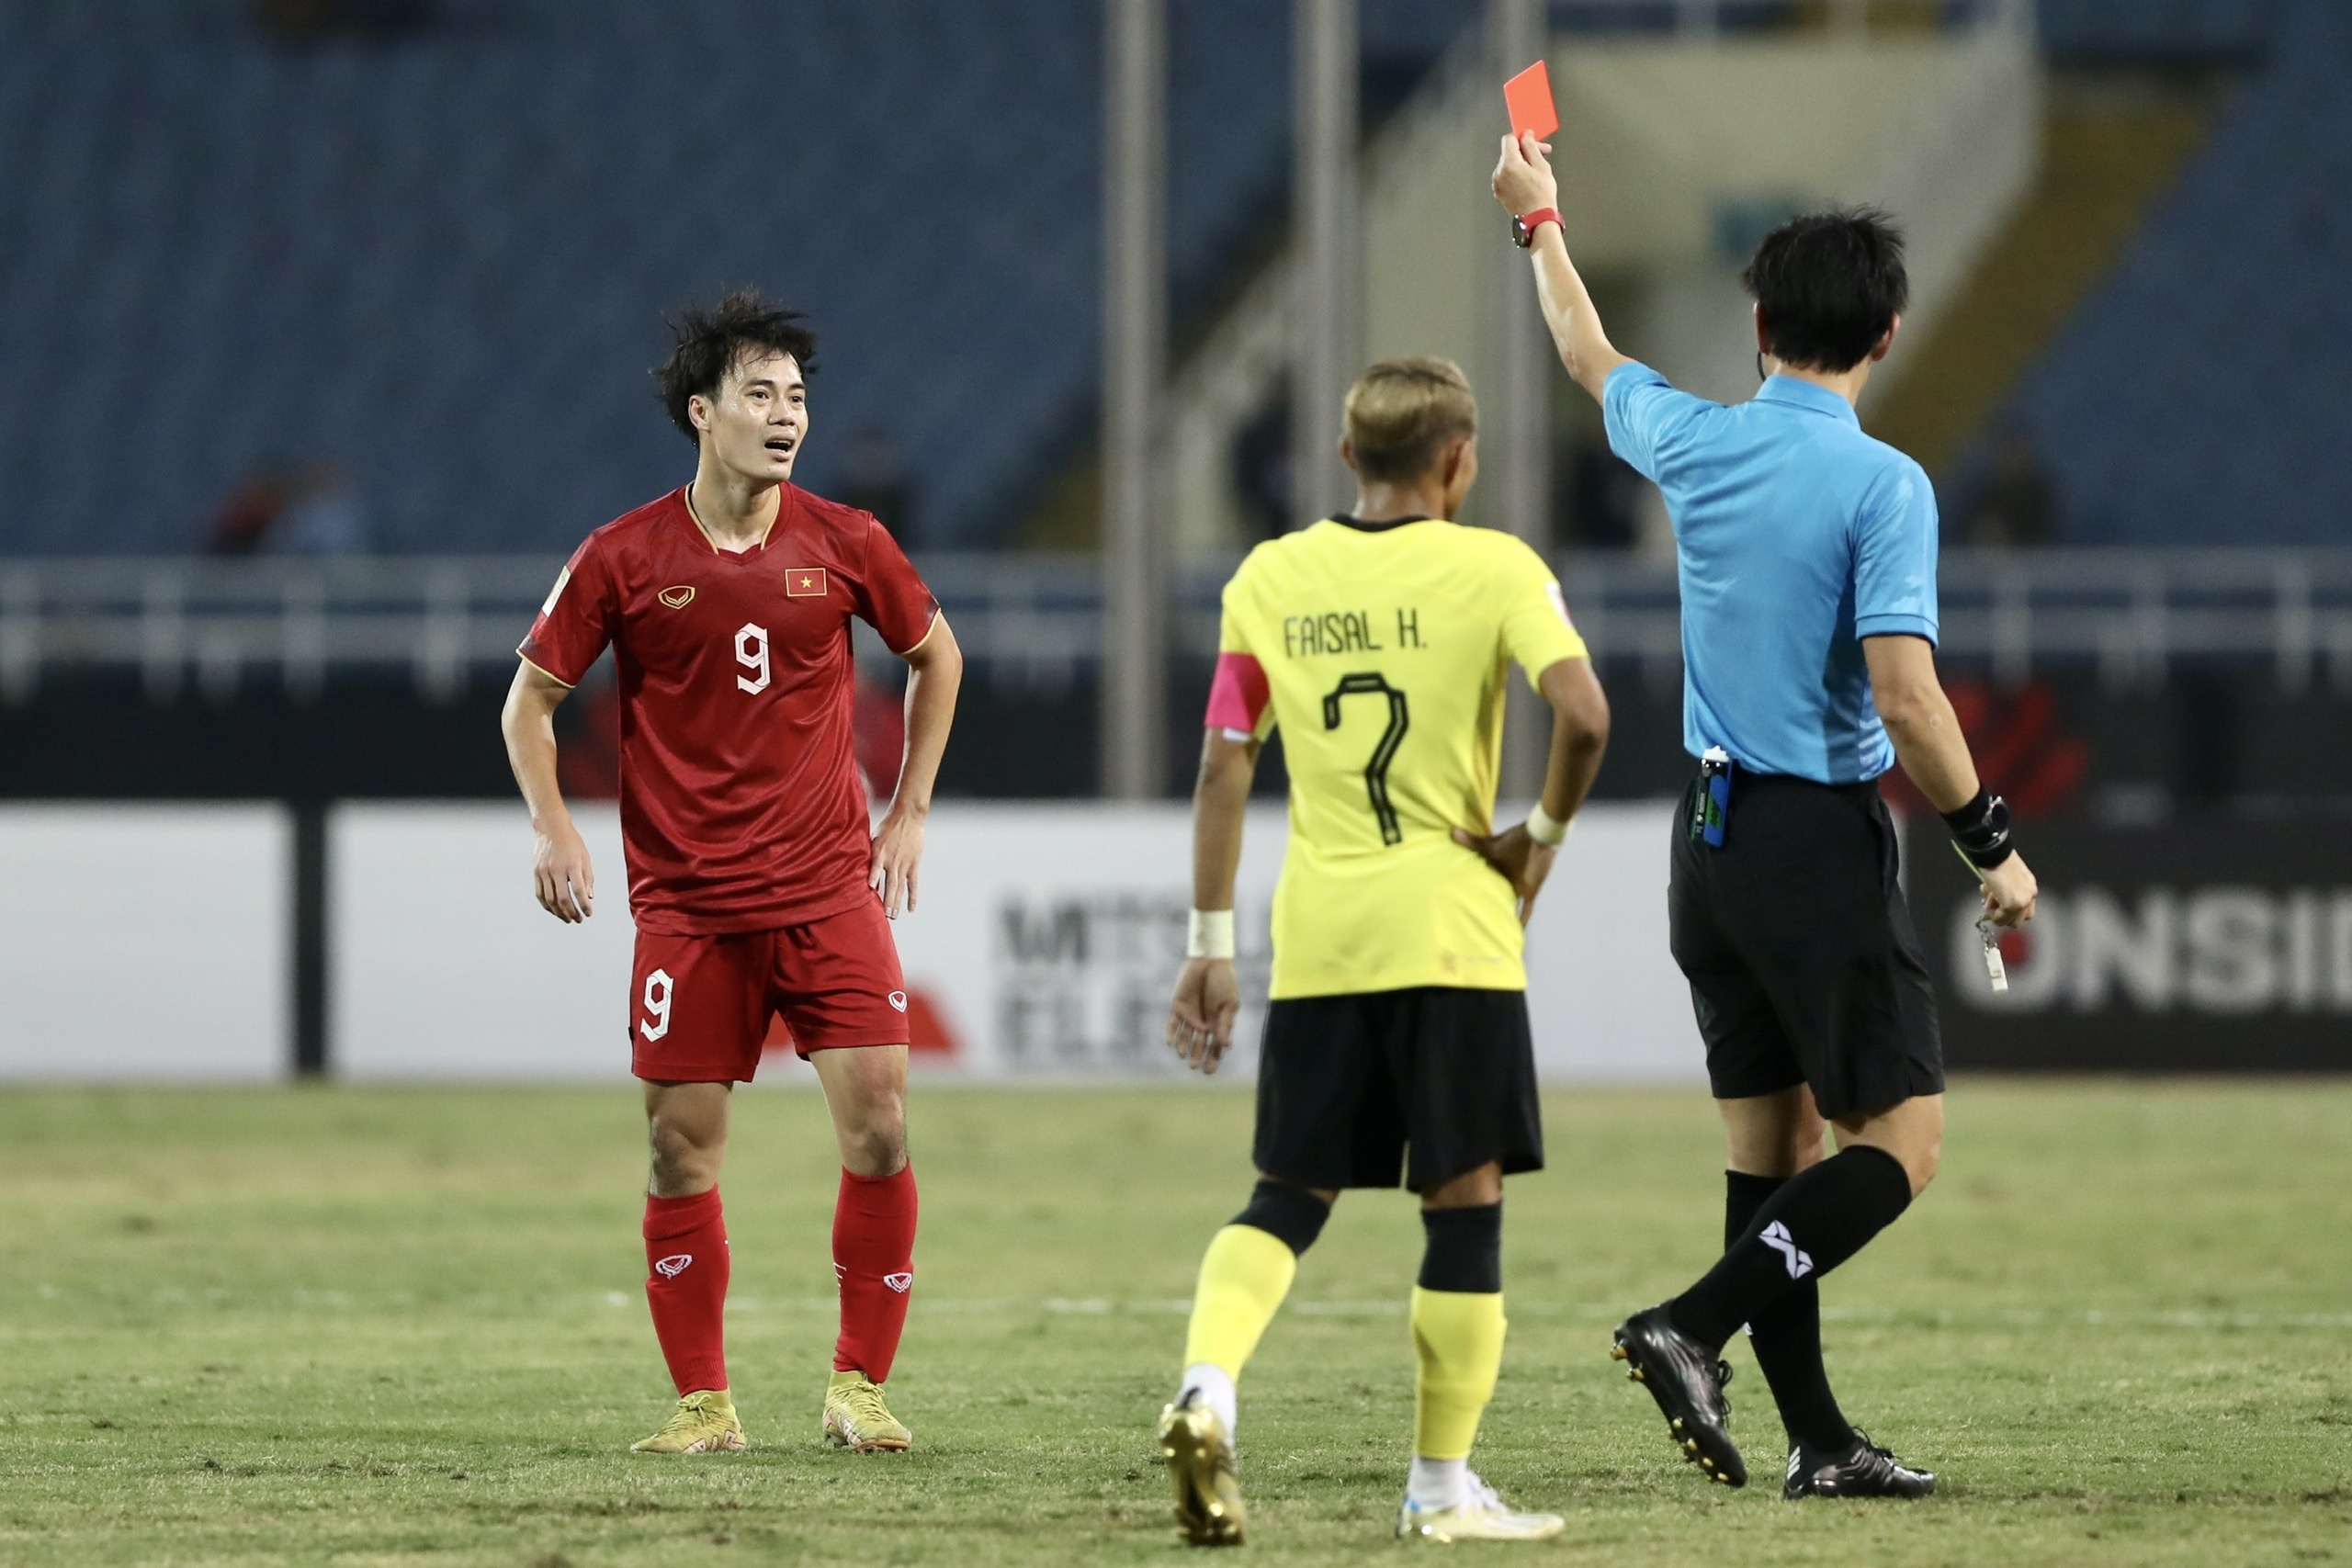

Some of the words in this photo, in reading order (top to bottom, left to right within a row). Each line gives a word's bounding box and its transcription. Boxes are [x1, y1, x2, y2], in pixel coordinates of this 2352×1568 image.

[734, 622, 771, 695] 9
[1283, 610, 1383, 659] FAISAL
[1397, 607, 1428, 649] H.
[1323, 671, 1409, 848] 7
[640, 968, 673, 1043] 9
